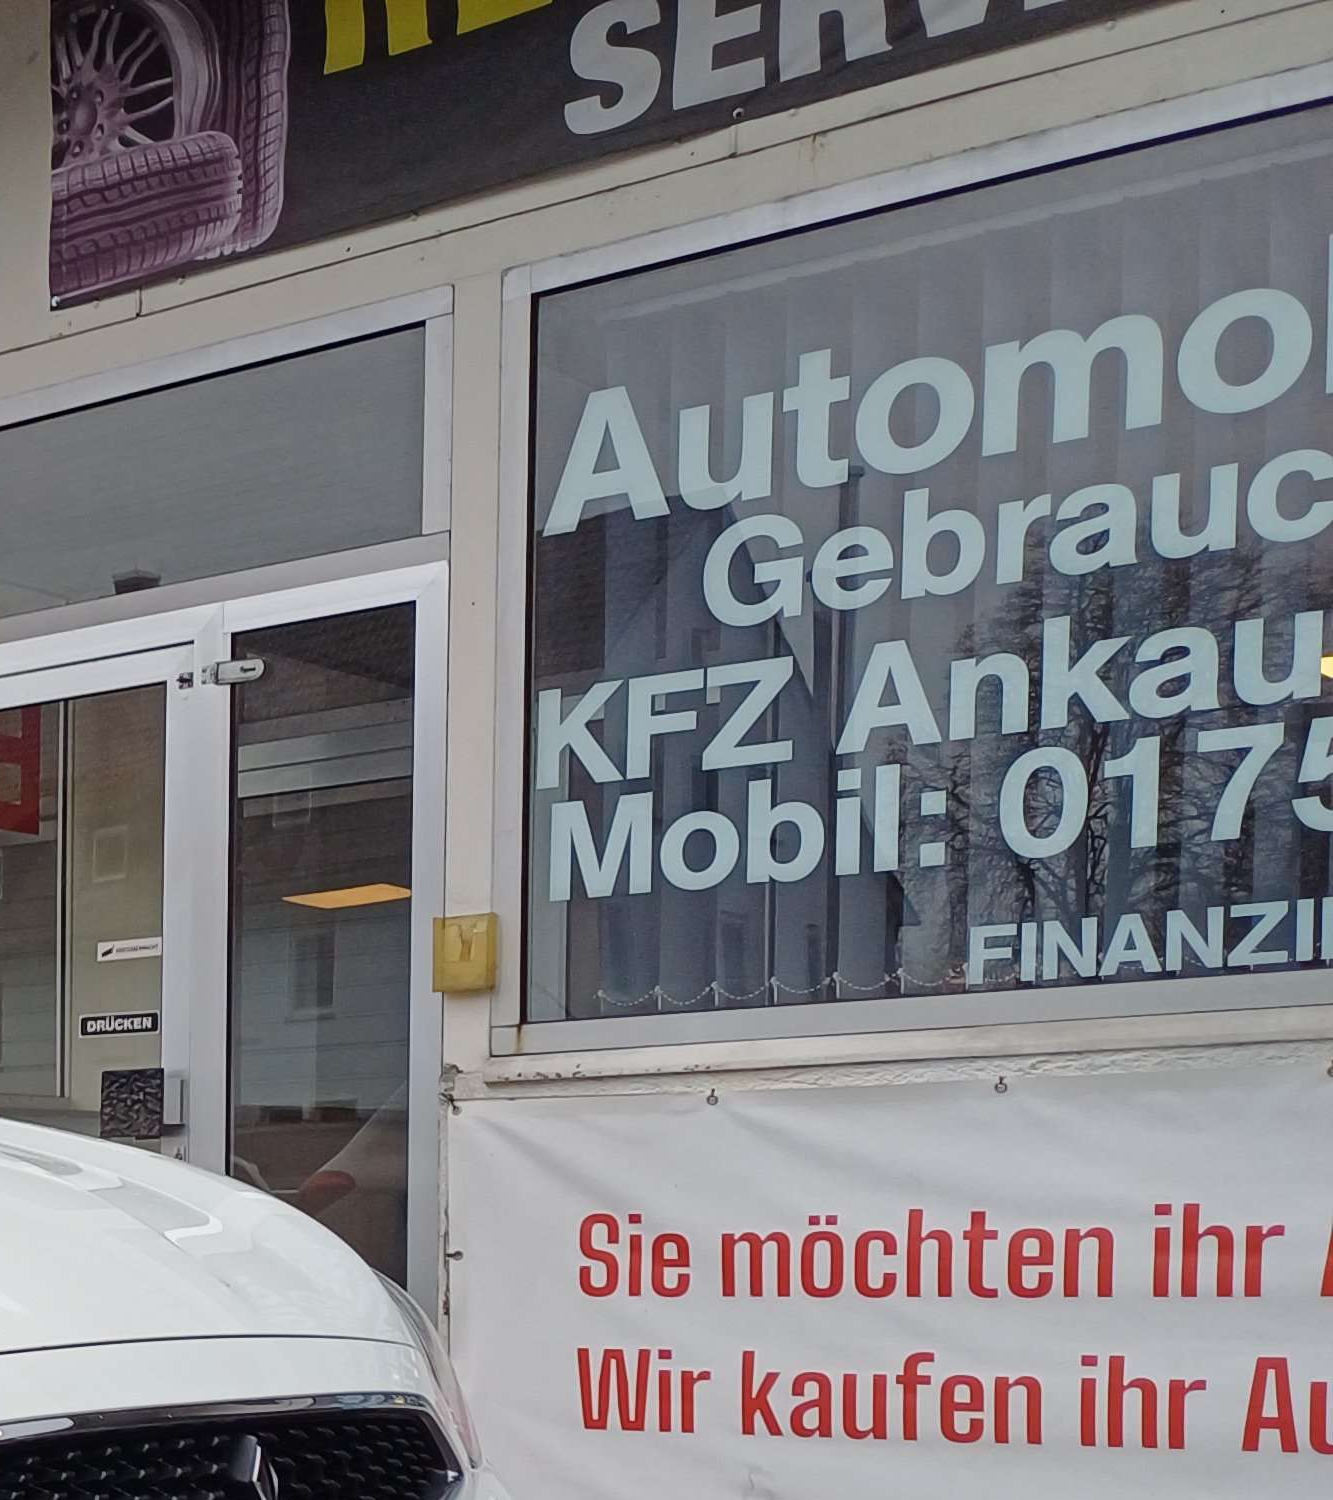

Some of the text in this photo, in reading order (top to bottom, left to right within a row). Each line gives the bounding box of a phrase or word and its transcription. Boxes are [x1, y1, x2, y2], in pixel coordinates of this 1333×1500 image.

[564, 0, 1071, 135] SER
[541, 228, 1333, 538] Automo
[702, 449, 1333, 627] Gebrauc
[536, 611, 1325, 791] KFZ Ankau
[549, 763, 946, 902] Mobil:
[968, 896, 1333, 986] FINANZI
[85, 1015, 153, 1033] DRÜCKEN
[577, 1212, 690, 1298] Sie
[721, 1208, 1114, 1298] möchten
[1152, 1203, 1285, 1298] ihr
[577, 1347, 711, 1434] Wir
[741, 1350, 1043, 1446] kaufen
[1078, 1355, 1207, 1450] ihr
